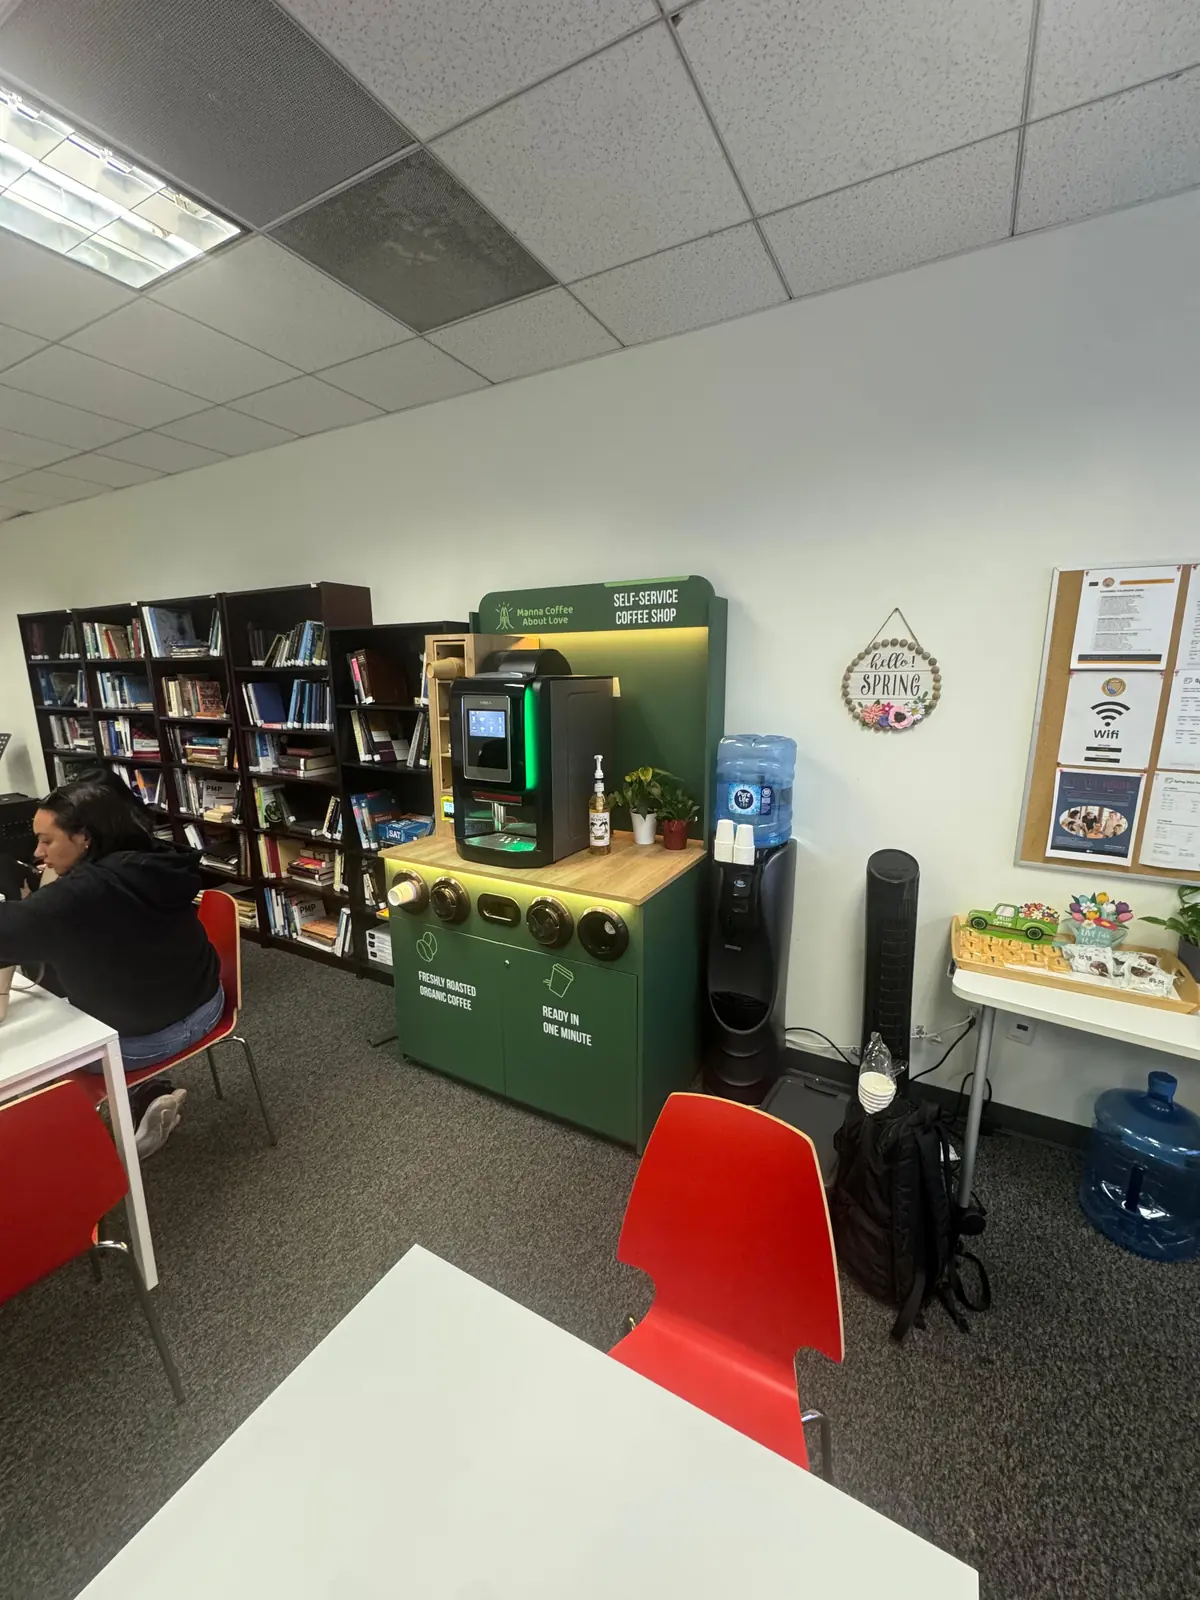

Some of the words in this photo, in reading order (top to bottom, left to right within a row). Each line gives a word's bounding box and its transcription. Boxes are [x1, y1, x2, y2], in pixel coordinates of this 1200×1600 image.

[613, 589, 679, 607] SELF-SERVICE
[516, 608, 544, 616] Manna
[545, 605, 574, 615] Coffee
[615, 610, 649, 624] COFFEE
[651, 608, 677, 623] SHOP
[522, 617, 547, 626] About
[548, 616, 569, 625] Love
[860, 673, 921, 697] SPRING
[1093, 729, 1119, 740] Wifi
[388, 829, 401, 839] SAT
[300, 903, 316, 914] PMP
[418, 970, 446, 988] FRESHLY
[446, 978, 477, 997] ROASTED
[419, 985, 447, 1003] ORGANIC
[447, 993, 472, 1011] COFFEE
[542, 1005, 569, 1023] READY
[570, 1012, 580, 1026] IN
[543, 1021, 560, 1037] ONE
[560, 1026, 592, 1046] MINUTE
